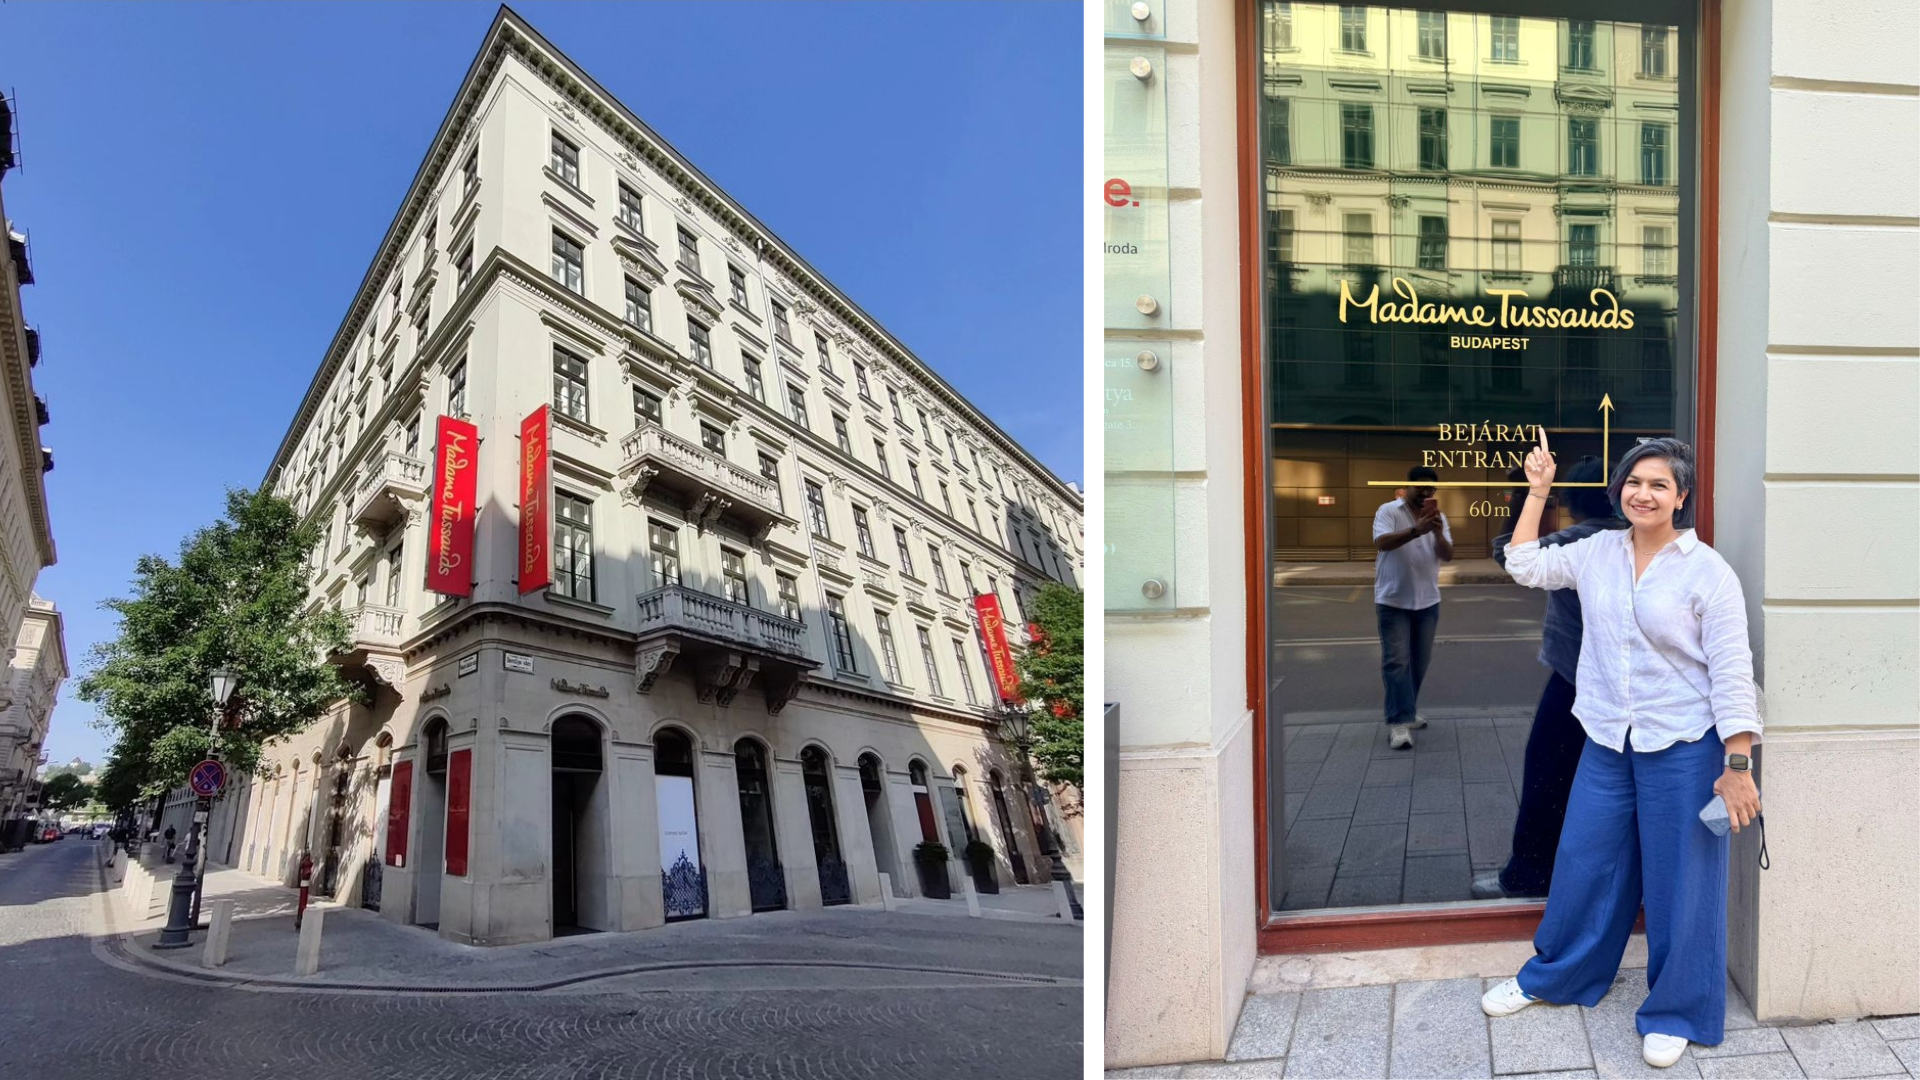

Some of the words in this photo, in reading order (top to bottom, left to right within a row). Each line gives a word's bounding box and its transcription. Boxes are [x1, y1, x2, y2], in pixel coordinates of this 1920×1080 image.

[1339, 277, 1496, 327] Madame
[1485, 288, 1635, 330] Tussauds
[1451, 336, 1530, 350] BUDAPEST
[525, 422, 541, 502] Madame
[1422, 450, 1557, 469] ENTRAN
[1438, 419, 1542, 446] BEJÁRAT
[442, 430, 468, 502] Madame
[438, 501, 462, 576] Tussauds
[525, 491, 541, 574] Tussauds
[1469, 500, 1511, 518] 60m
[980, 607, 999, 649] Madame
[992, 645, 1013, 692] Tussauds
